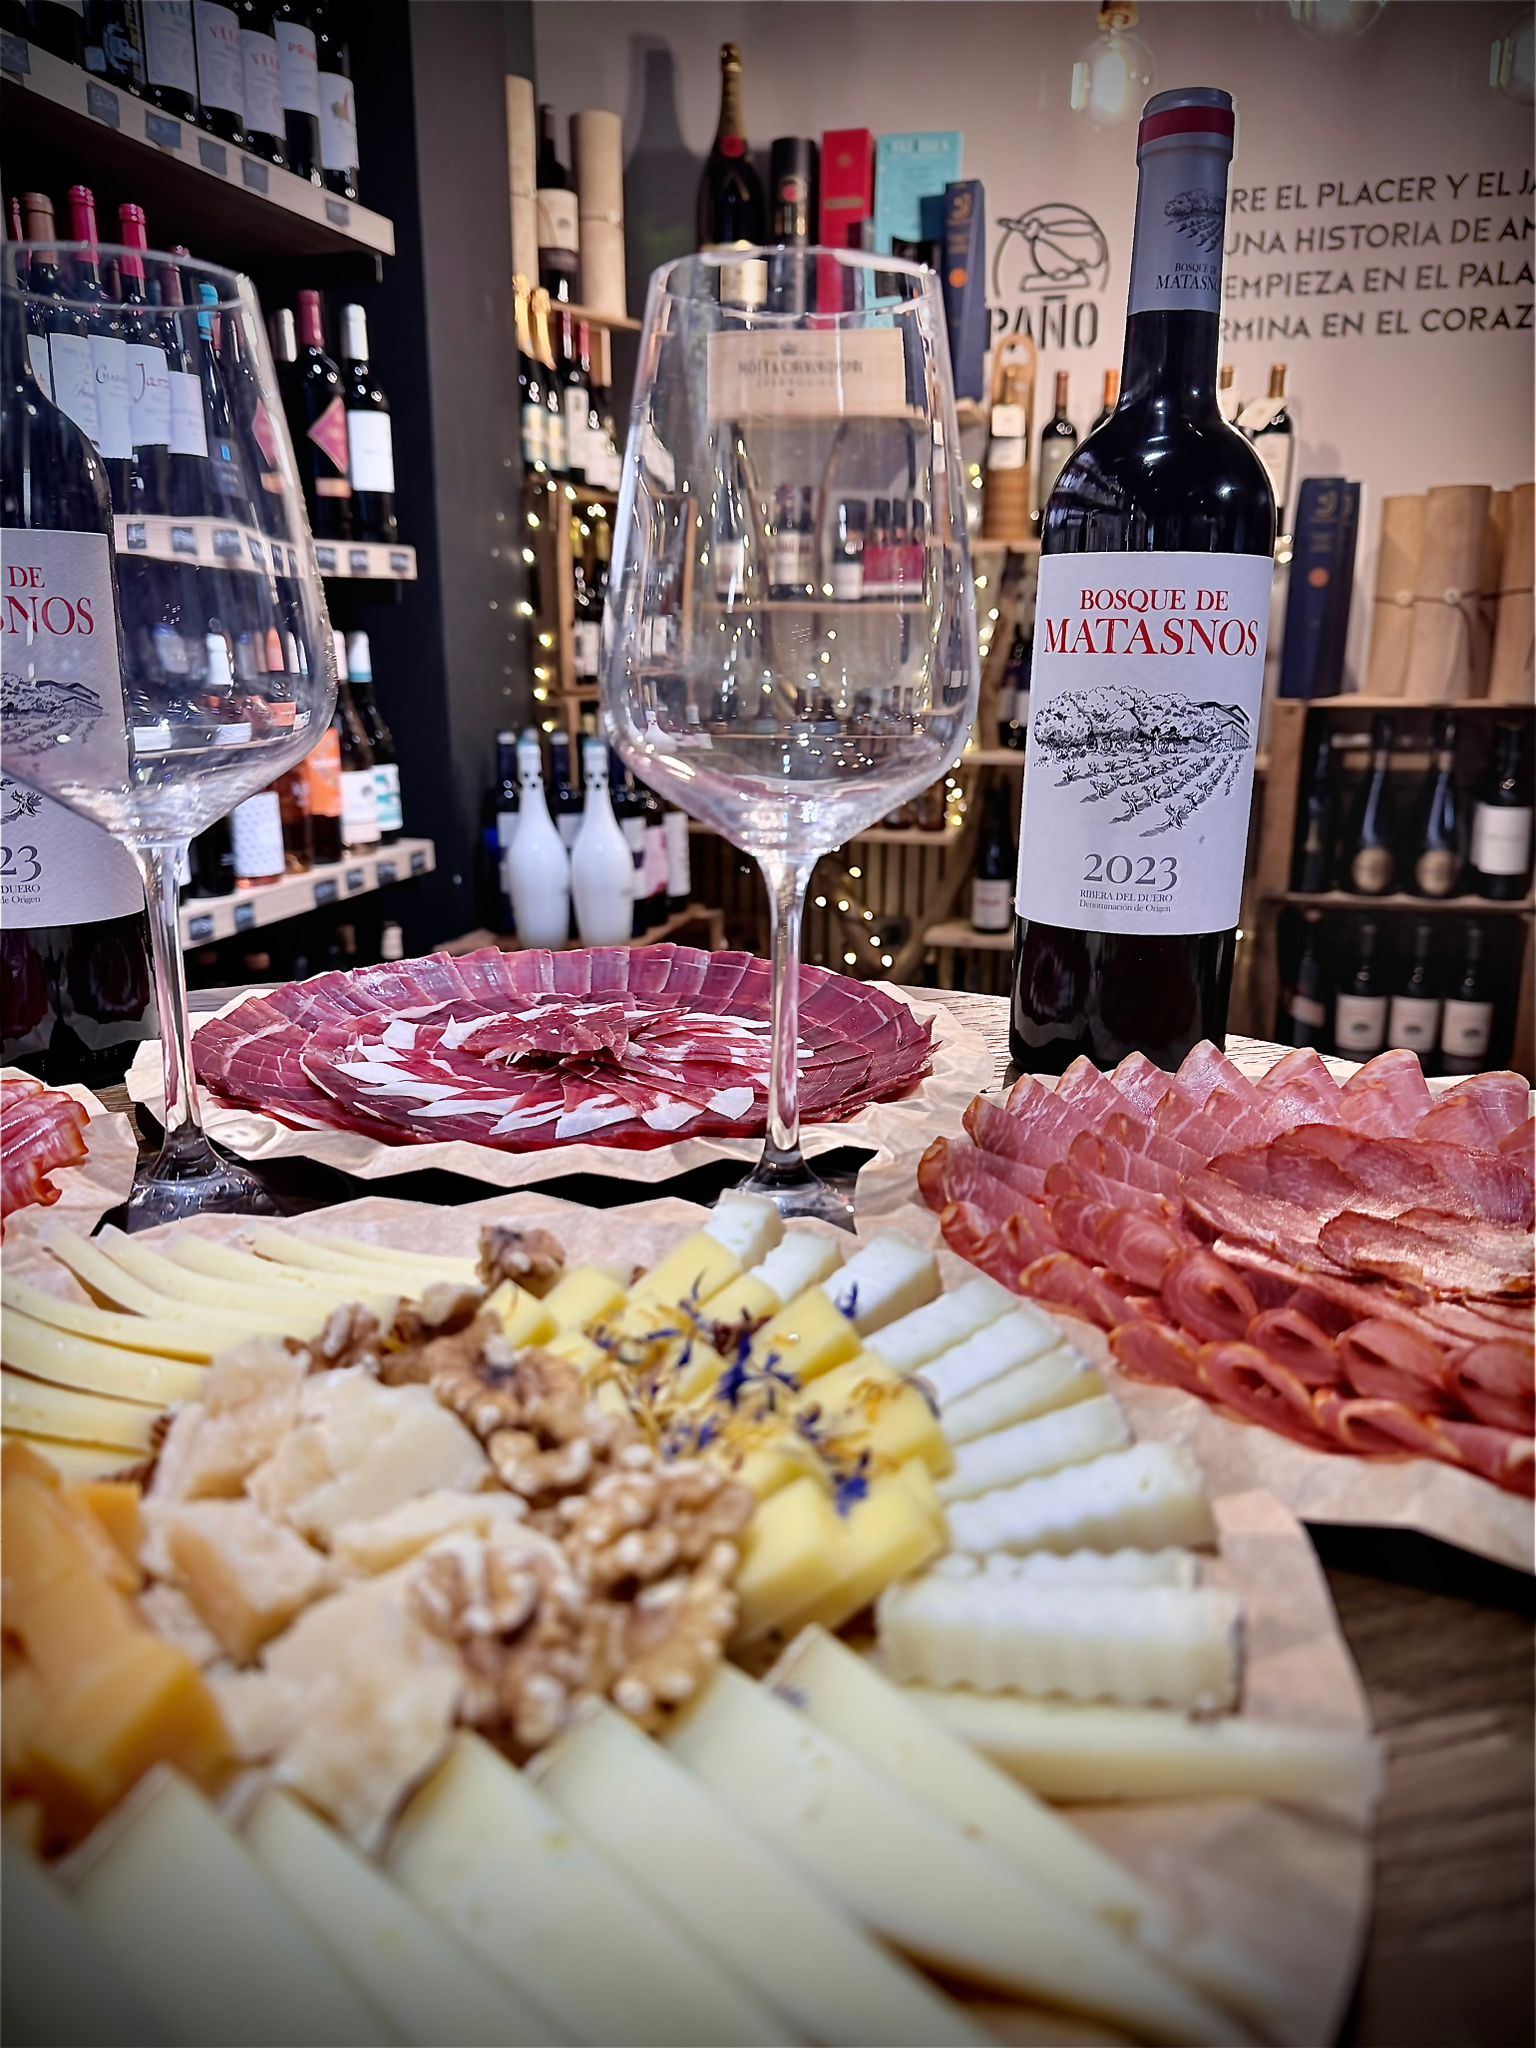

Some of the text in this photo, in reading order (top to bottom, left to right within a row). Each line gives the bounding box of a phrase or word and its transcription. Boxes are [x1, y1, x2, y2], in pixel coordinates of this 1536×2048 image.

[1230, 187, 1267, 213] RE
[1275, 184, 1309, 211] EL
[1317, 176, 1437, 208] PLACER
[1445, 173, 1470, 199] Y
[1477, 171, 1511, 198] EL
[1223, 230, 1287, 256] UNA
[1295, 221, 1441, 253] HISTORIA
[1450, 217, 1492, 244] DE
[1225, 260, 1535, 299] EMPIEZA EN EL PALA
[1321, 311, 1364, 338] EN
[1376, 310, 1409, 336] EL
[1420, 304, 1534, 332] CORAZ
[7, 566, 45, 588] DE
[0, 595, 95, 635] NOS
[1080, 589, 1229, 613] BOSQUE DE
[1044, 618, 1259, 656] MATASNOS
[0, 845, 42, 882] 23
[1083, 853, 1178, 892] 2023
[1, 884, 41, 894] DUERO
[11, 895, 41, 904] Origen
[1079, 899, 1171, 913] Denominación de Origen
[1080, 889, 1173, 903] RIBERA DEL DUERO
